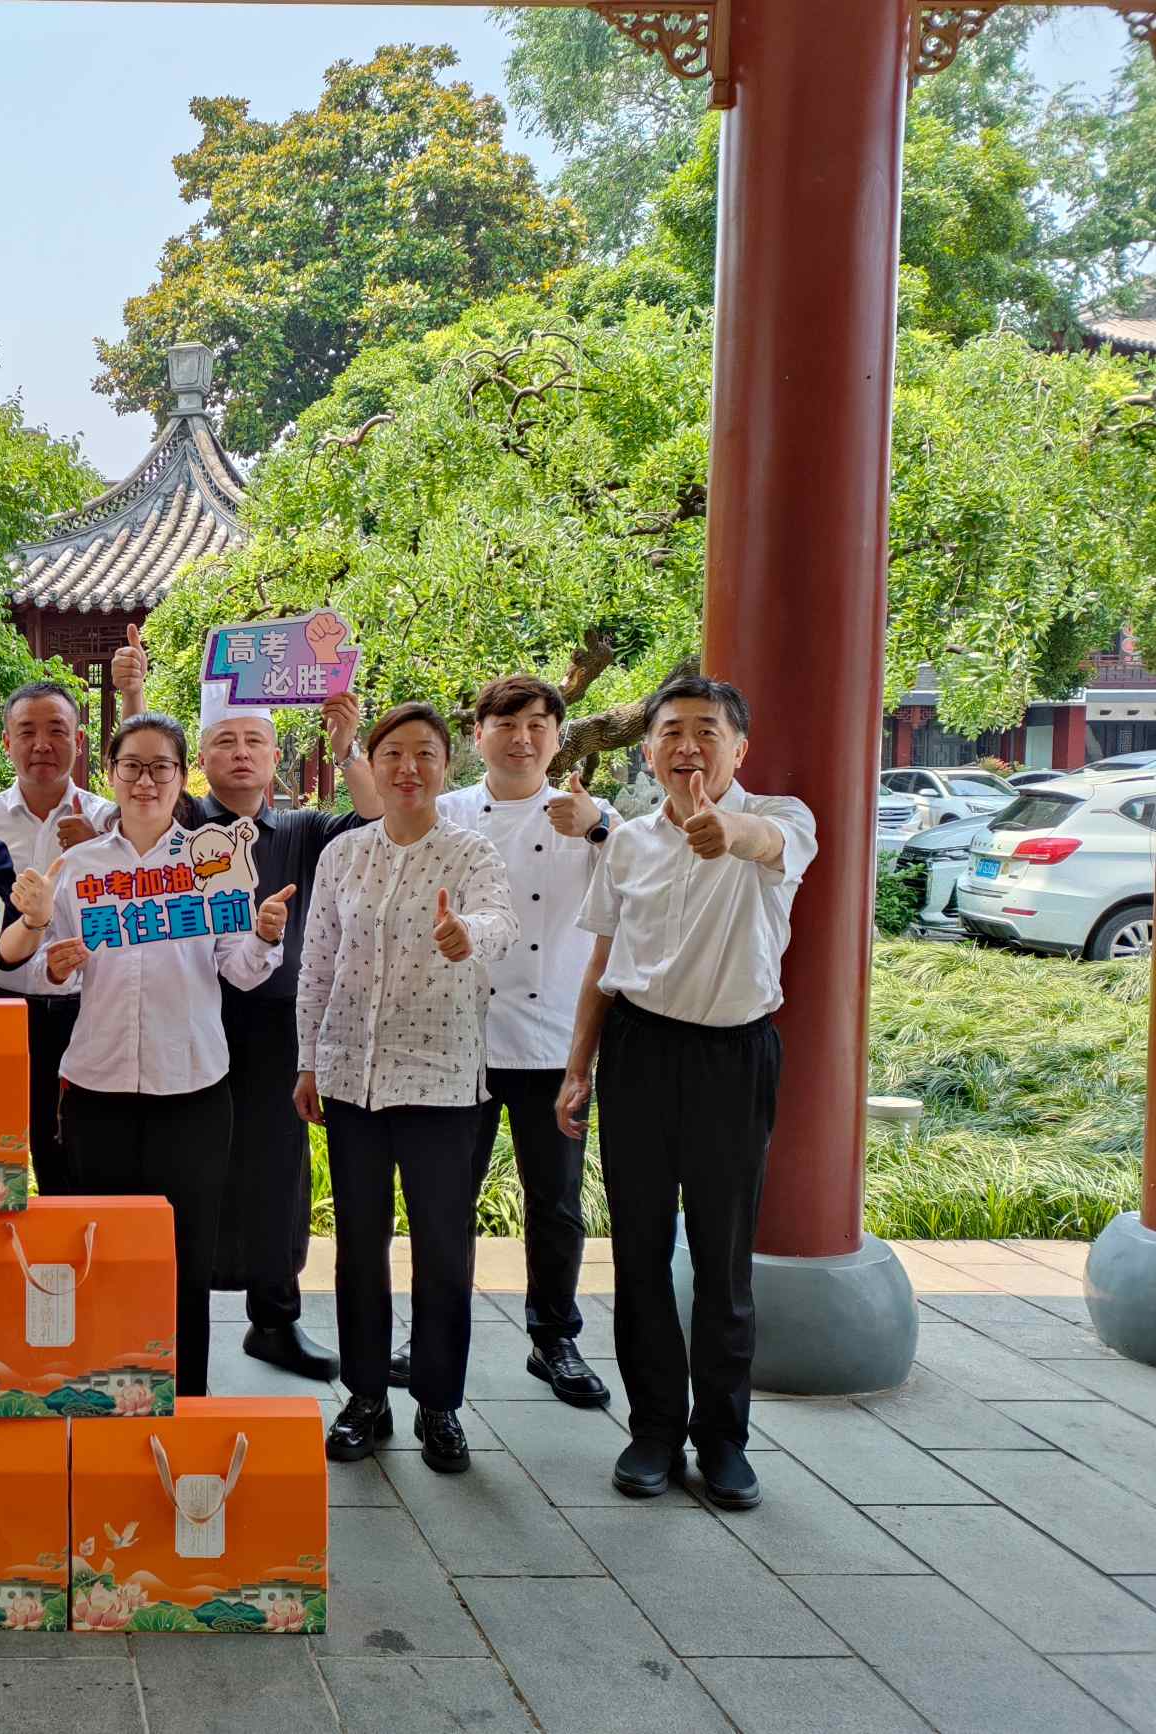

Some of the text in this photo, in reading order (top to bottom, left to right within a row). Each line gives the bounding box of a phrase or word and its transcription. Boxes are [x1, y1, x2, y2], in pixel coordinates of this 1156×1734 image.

[226, 631, 290, 665] 高考
[262, 664, 329, 697] 必胜
[76, 863, 194, 904] 中考加油
[80, 889, 253, 951] 勇往直前
